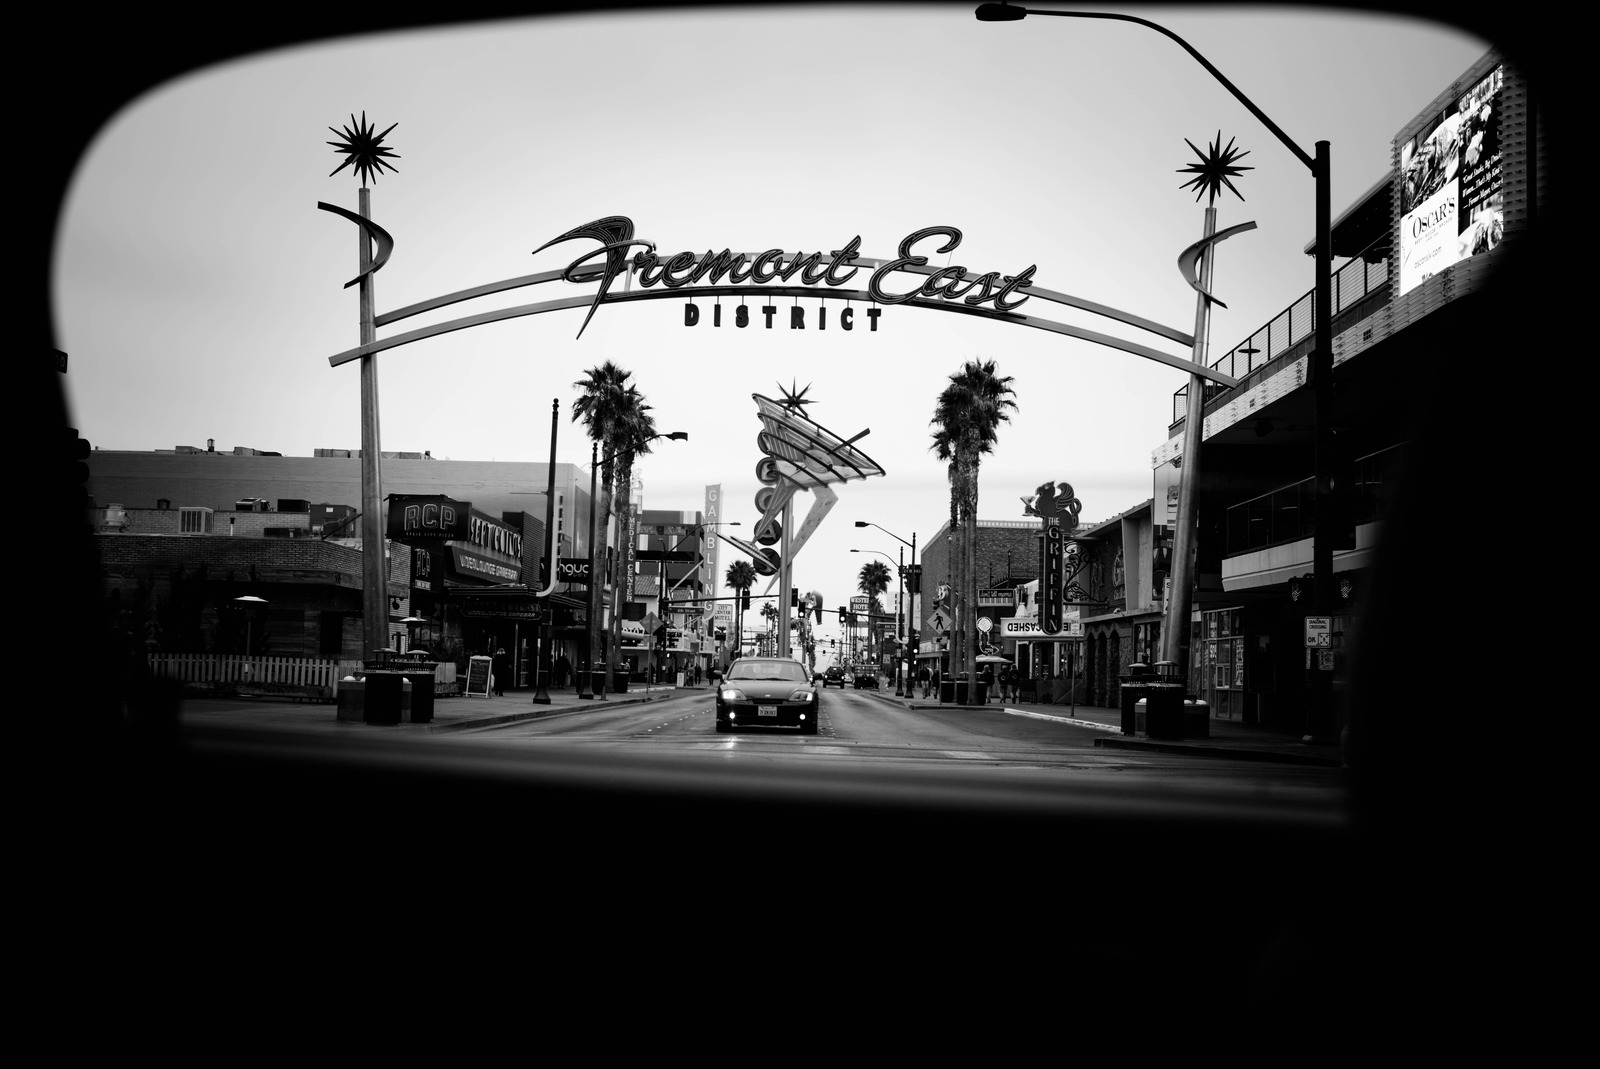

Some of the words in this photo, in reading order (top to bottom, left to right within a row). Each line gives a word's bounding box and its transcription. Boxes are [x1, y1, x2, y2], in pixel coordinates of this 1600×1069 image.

[532, 215, 860, 340] Fremont
[868, 225, 1036, 311] East
[684, 303, 881, 332] DISTRICT
[404, 503, 458, 532] RCP
[1048, 515, 1061, 526] THE
[627, 516, 636, 561] MEDICAL
[704, 489, 717, 612] GAMBLING
[626, 564, 635, 602] CENTER
[1048, 527, 1060, 632] GRIFFIN
